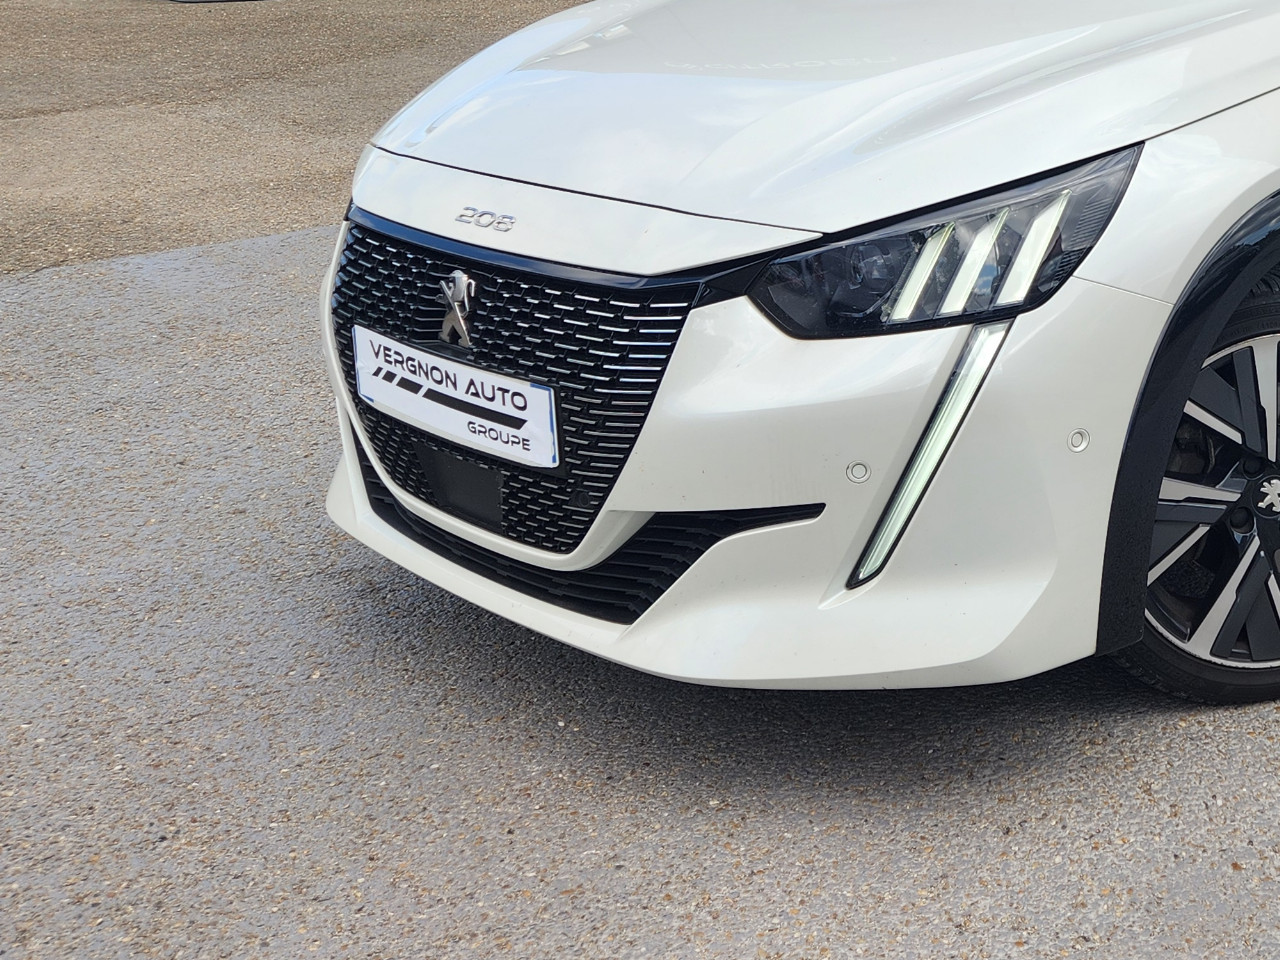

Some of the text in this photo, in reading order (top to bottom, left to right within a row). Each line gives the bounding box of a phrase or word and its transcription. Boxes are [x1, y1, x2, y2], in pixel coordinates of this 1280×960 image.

[455, 206, 517, 233] 208
[370, 339, 528, 412] VERGNON AUTO
[467, 421, 531, 452] GROUPE
